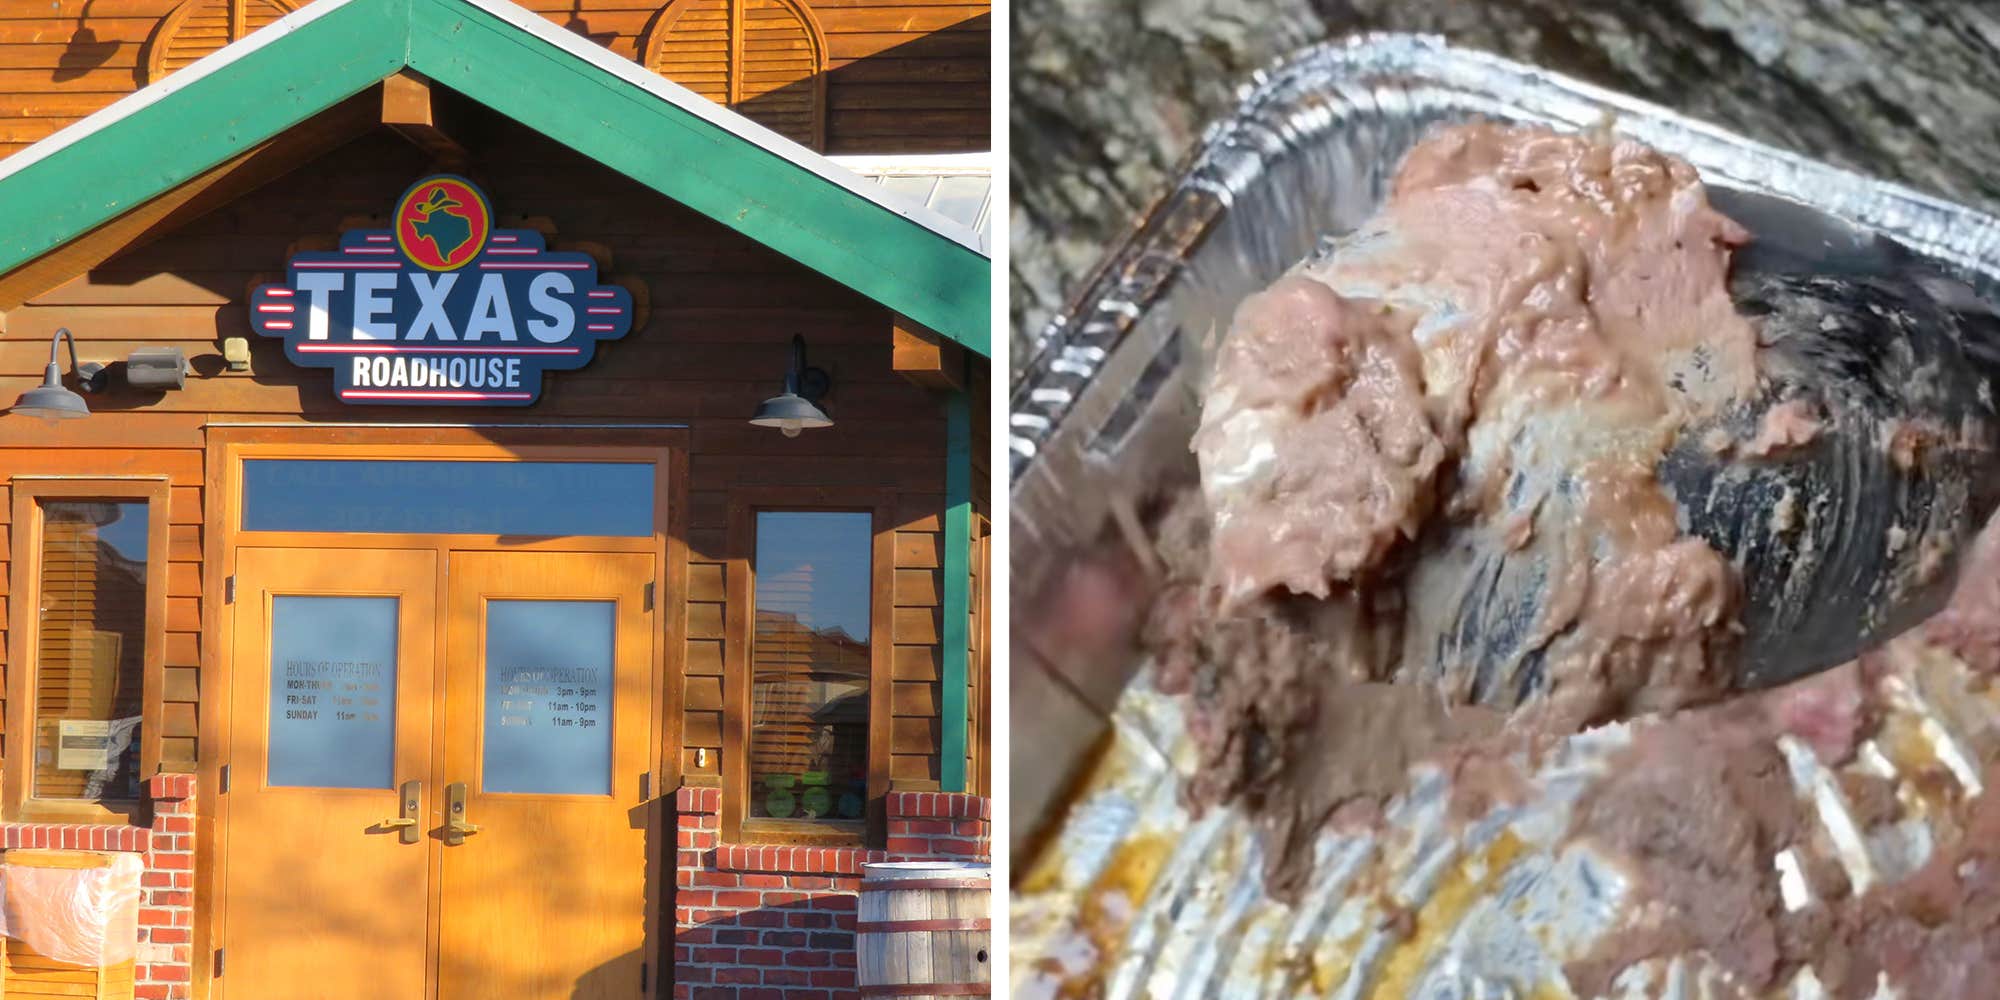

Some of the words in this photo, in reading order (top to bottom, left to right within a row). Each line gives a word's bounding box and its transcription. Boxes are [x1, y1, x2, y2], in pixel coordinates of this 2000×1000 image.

[297, 272, 576, 343] TEXAS
[353, 356, 521, 388] ROADHOUSE
[556, 686, 574, 697] 3pm
[580, 686, 597, 698] 9pm
[286, 695, 317, 704] FRI-SAT
[548, 701, 568, 711] 11am
[576, 702, 597, 713] 10pm
[286, 710, 318, 720] SUNDAY
[552, 716, 573, 726] 11am
[580, 717, 596, 728] 9pm
